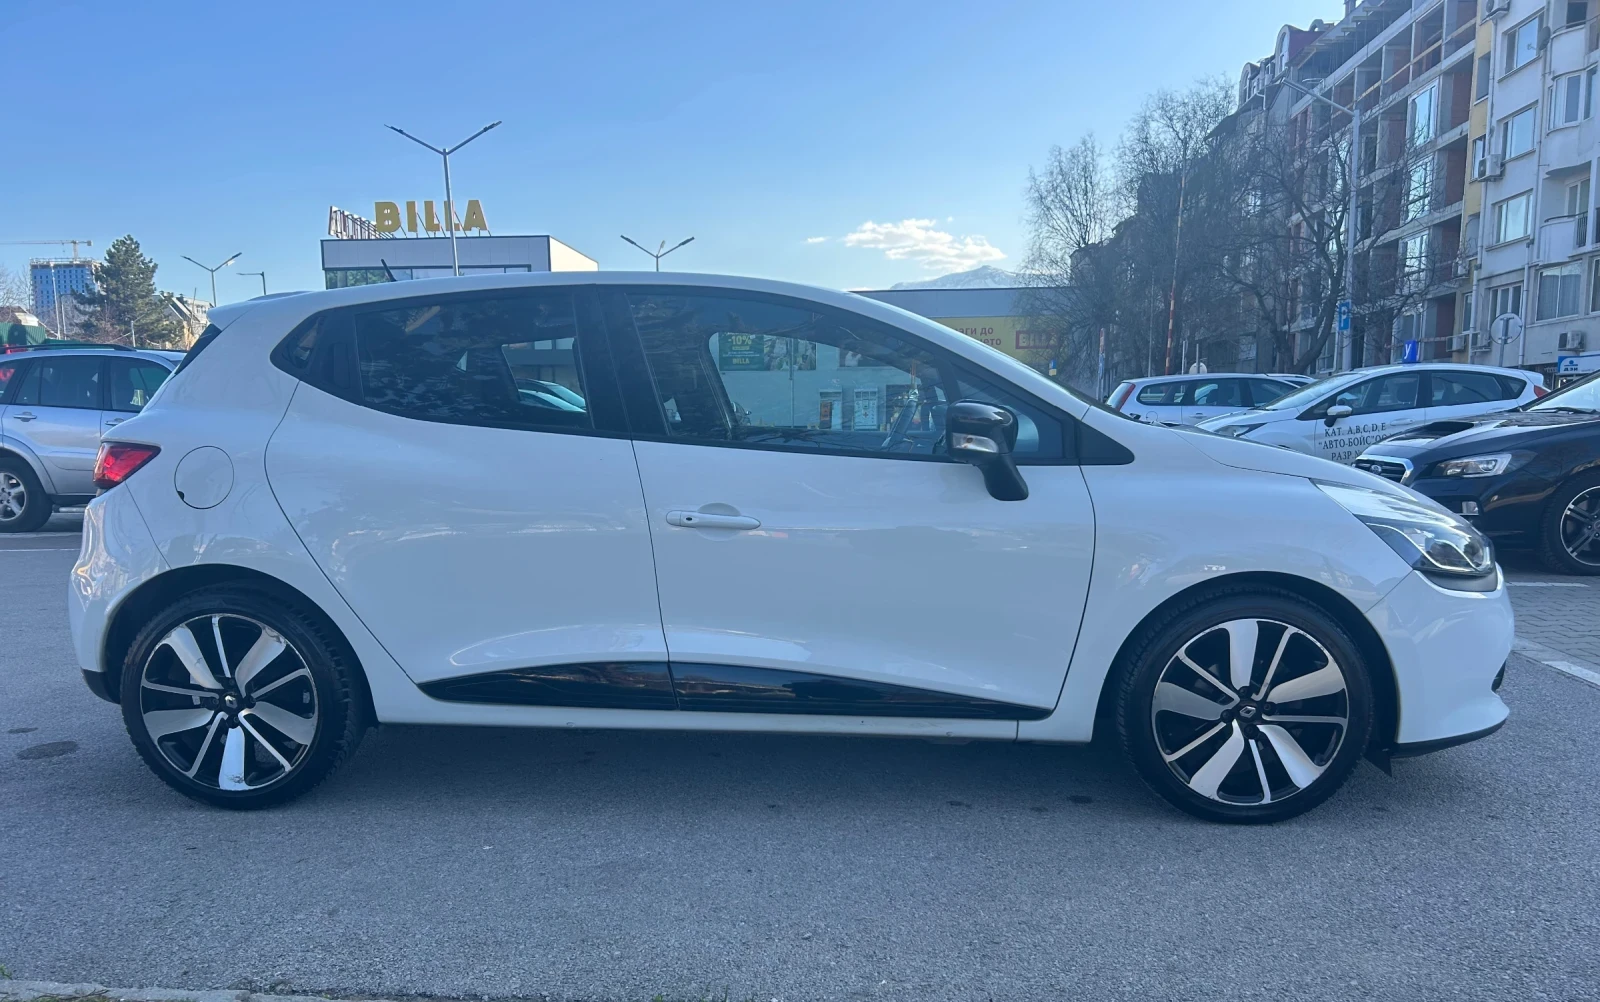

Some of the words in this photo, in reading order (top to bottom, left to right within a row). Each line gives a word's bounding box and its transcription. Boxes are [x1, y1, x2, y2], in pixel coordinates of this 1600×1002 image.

[374, 199, 489, 233] BILLA
[956, 327, 977, 335] аги
[979, 327, 994, 336] до
[728, 335, 752, 345] -10%
[978, 338, 1002, 346] ето
[1324, 427, 1344, 437] КАТ.
